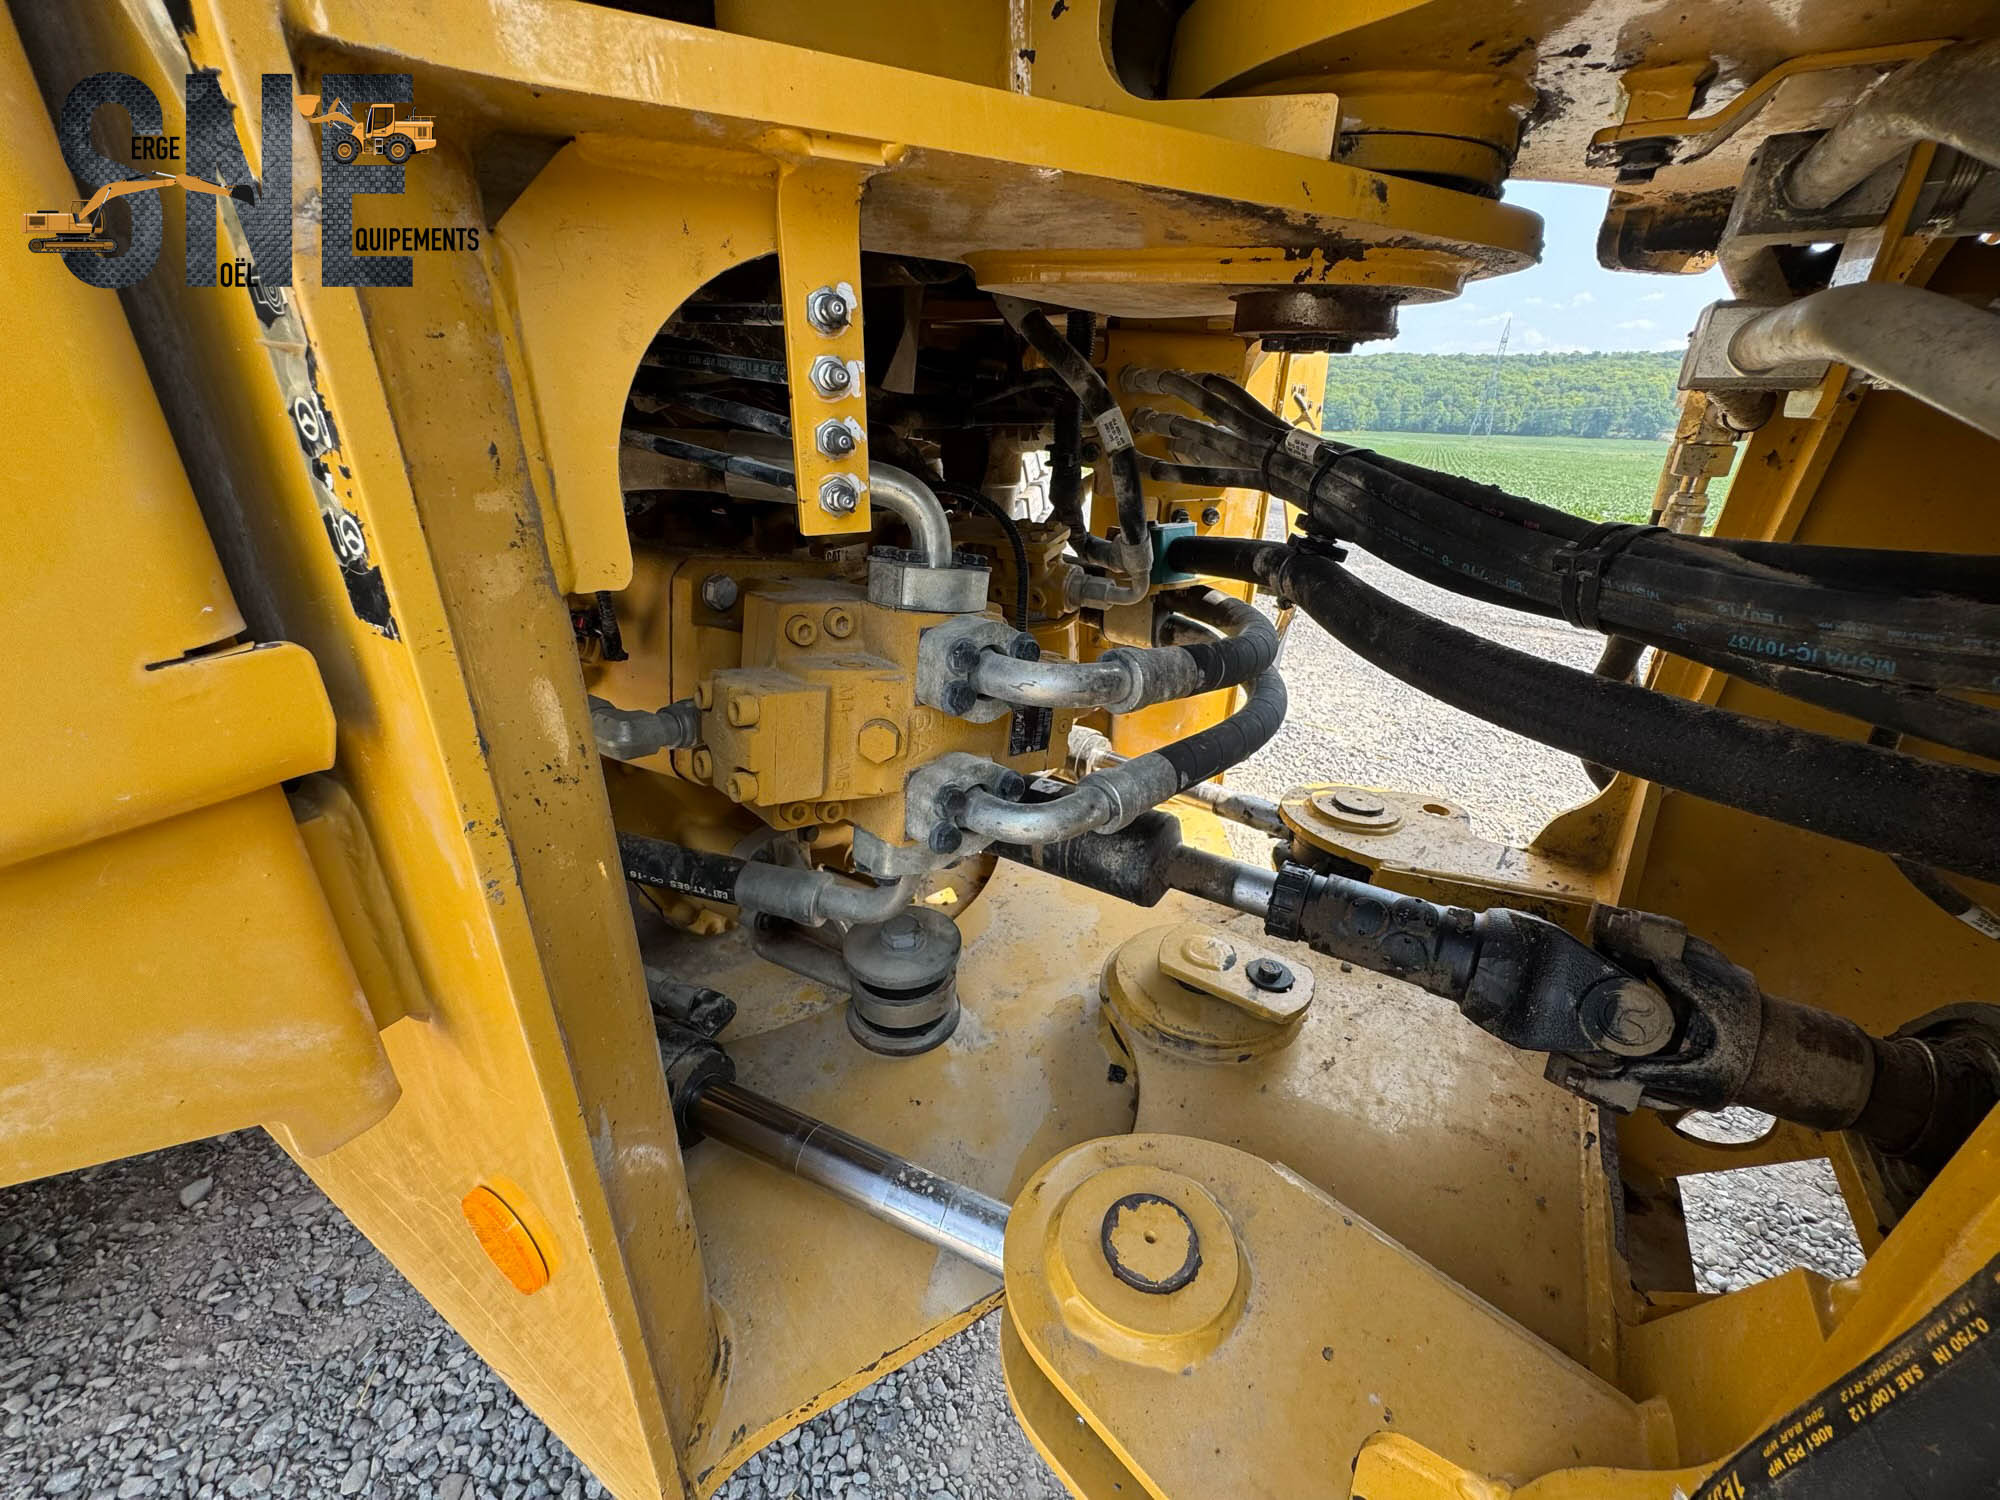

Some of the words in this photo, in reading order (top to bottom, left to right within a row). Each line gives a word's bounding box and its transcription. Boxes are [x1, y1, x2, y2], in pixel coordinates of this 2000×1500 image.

[1950, 1317, 1990, 1351] 0.750
[1931, 1344, 1953, 1366] IN
[1895, 1363, 1926, 1392] SAE
[1779, 1421, 1804, 1444] BAR
[1805, 1424, 1834, 1451] 4061
[1763, 1442, 1780, 1458] WP
[1785, 1445, 1806, 1465] PSI
[1767, 1459, 1786, 1478] WP
